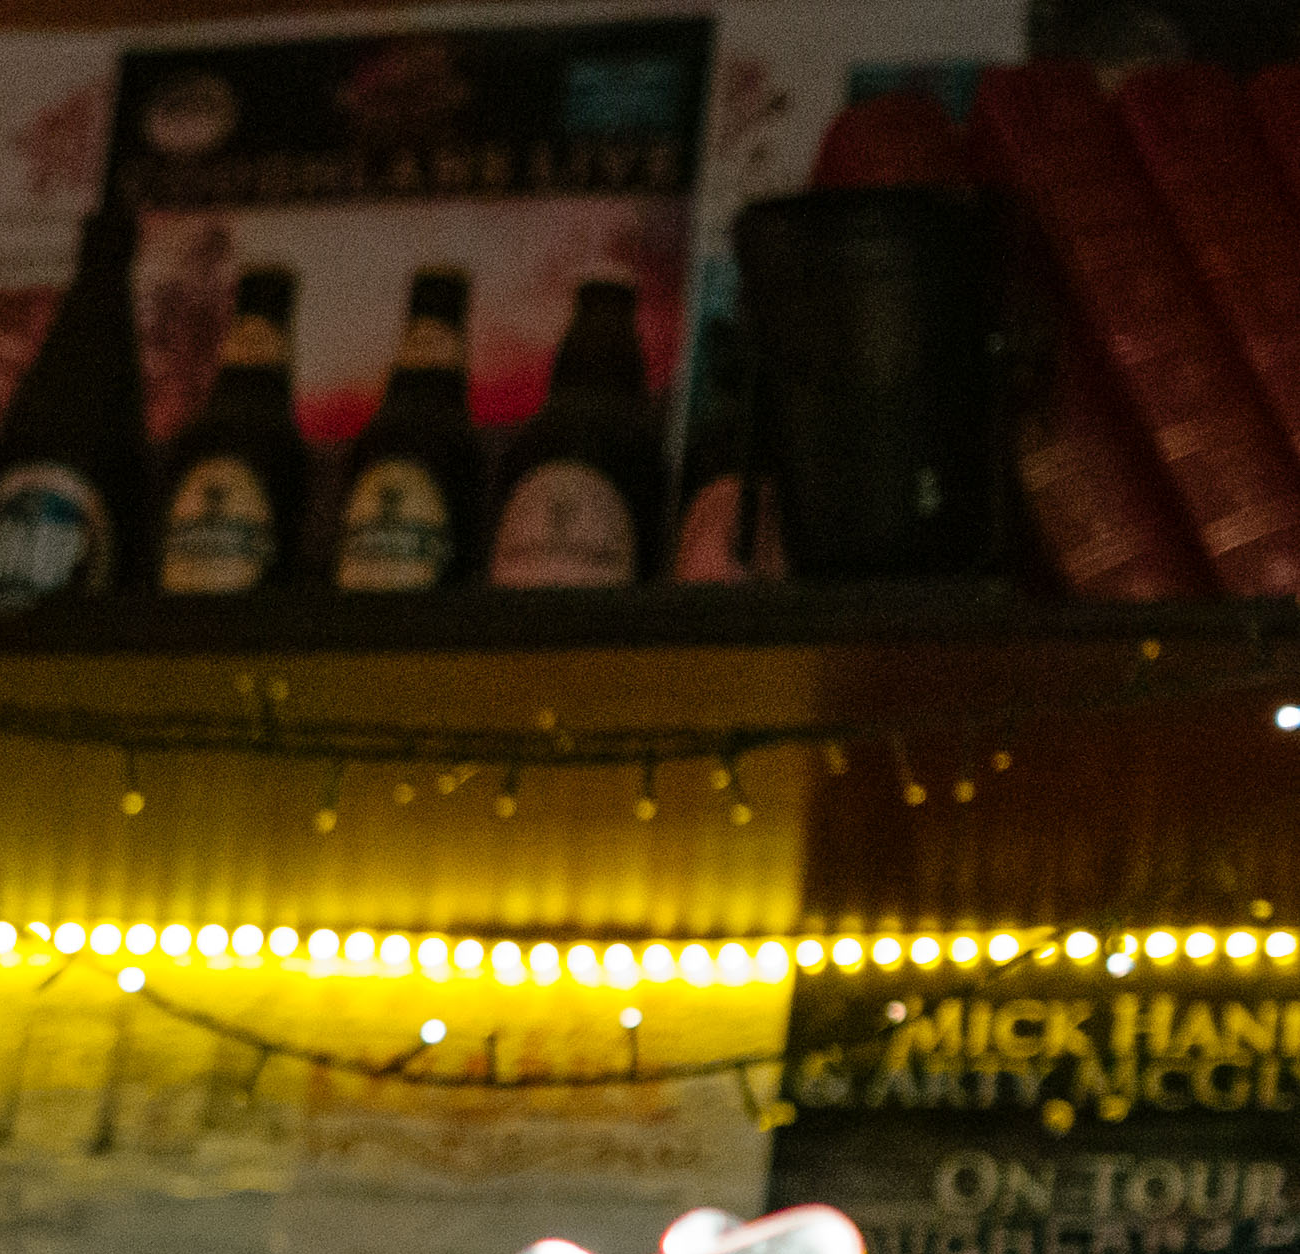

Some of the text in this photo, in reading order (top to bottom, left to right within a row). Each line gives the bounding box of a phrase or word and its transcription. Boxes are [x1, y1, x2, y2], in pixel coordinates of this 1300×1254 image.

[901, 993, 1300, 1060] MICK HAN
[933, 1148, 1288, 1215] ON TOUR
